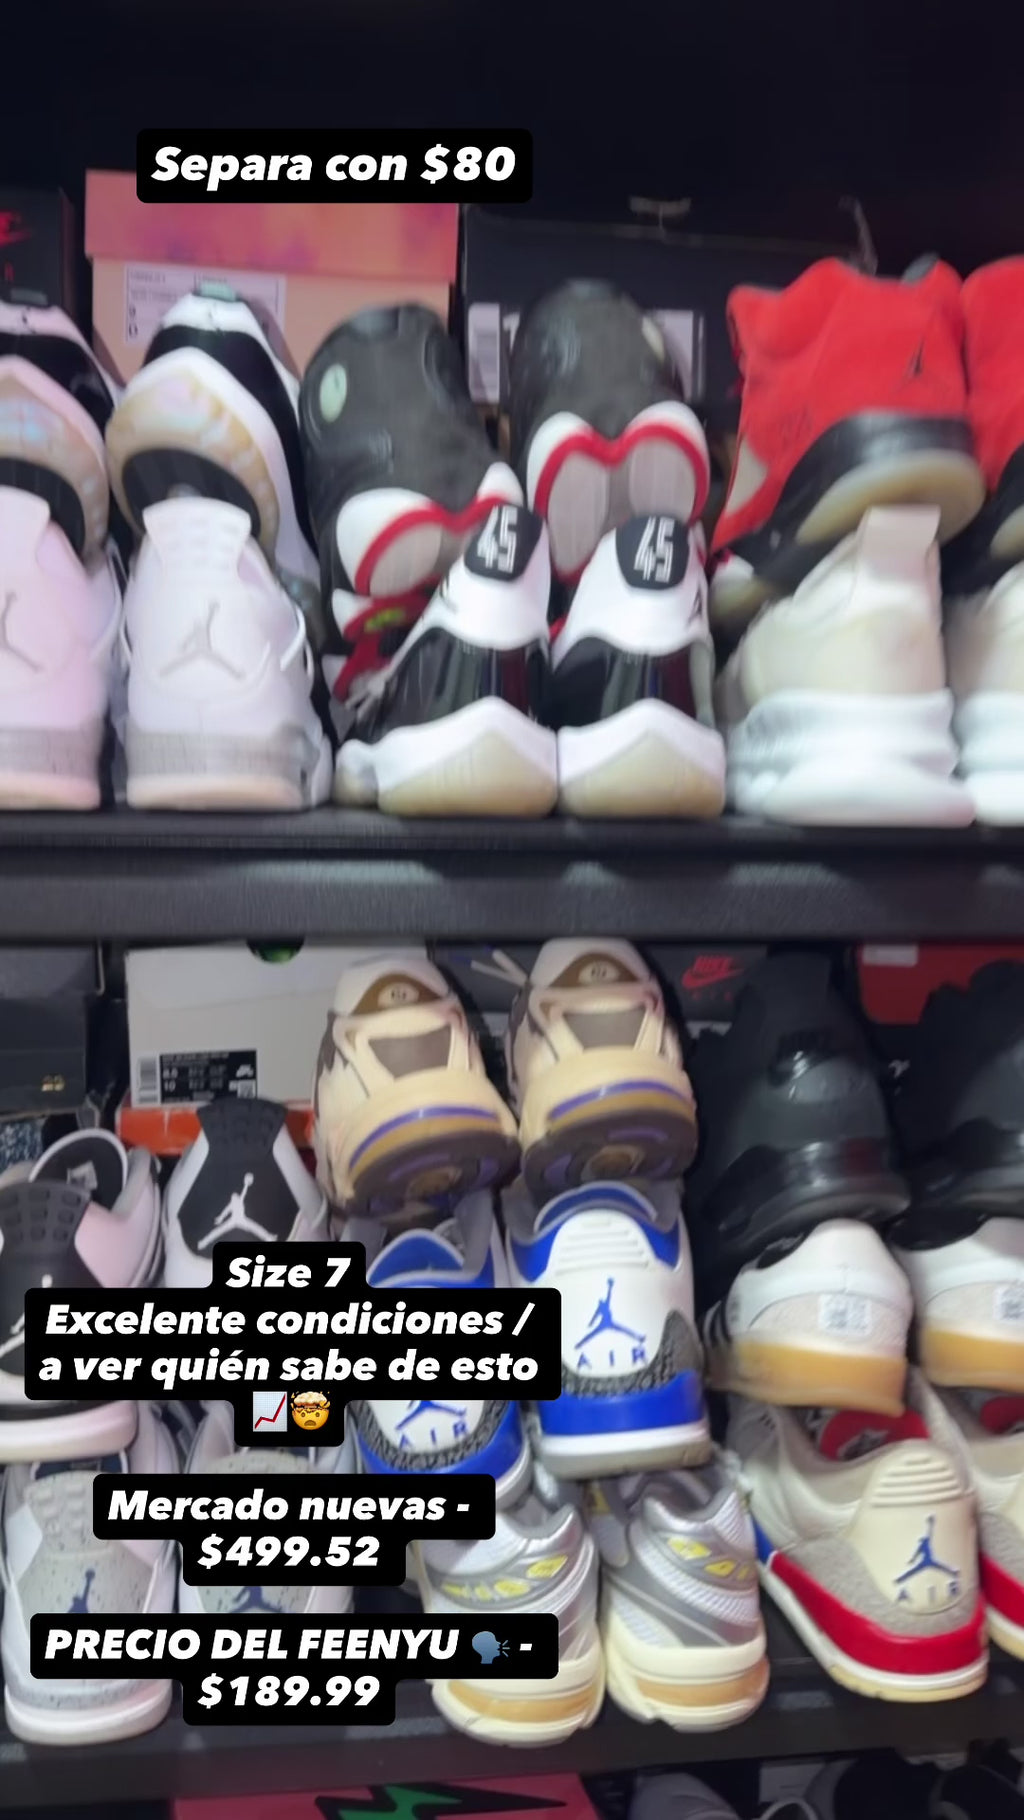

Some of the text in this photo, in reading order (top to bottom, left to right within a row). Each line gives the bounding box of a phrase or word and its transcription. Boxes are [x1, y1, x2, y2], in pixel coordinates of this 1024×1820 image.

[476, 503, 518, 574] 45
[633, 516, 675, 583] 45
[577, 1344, 648, 1371] AIR
[398, 1419, 469, 1450] AIR
[895, 1579, 961, 1603] AIR
